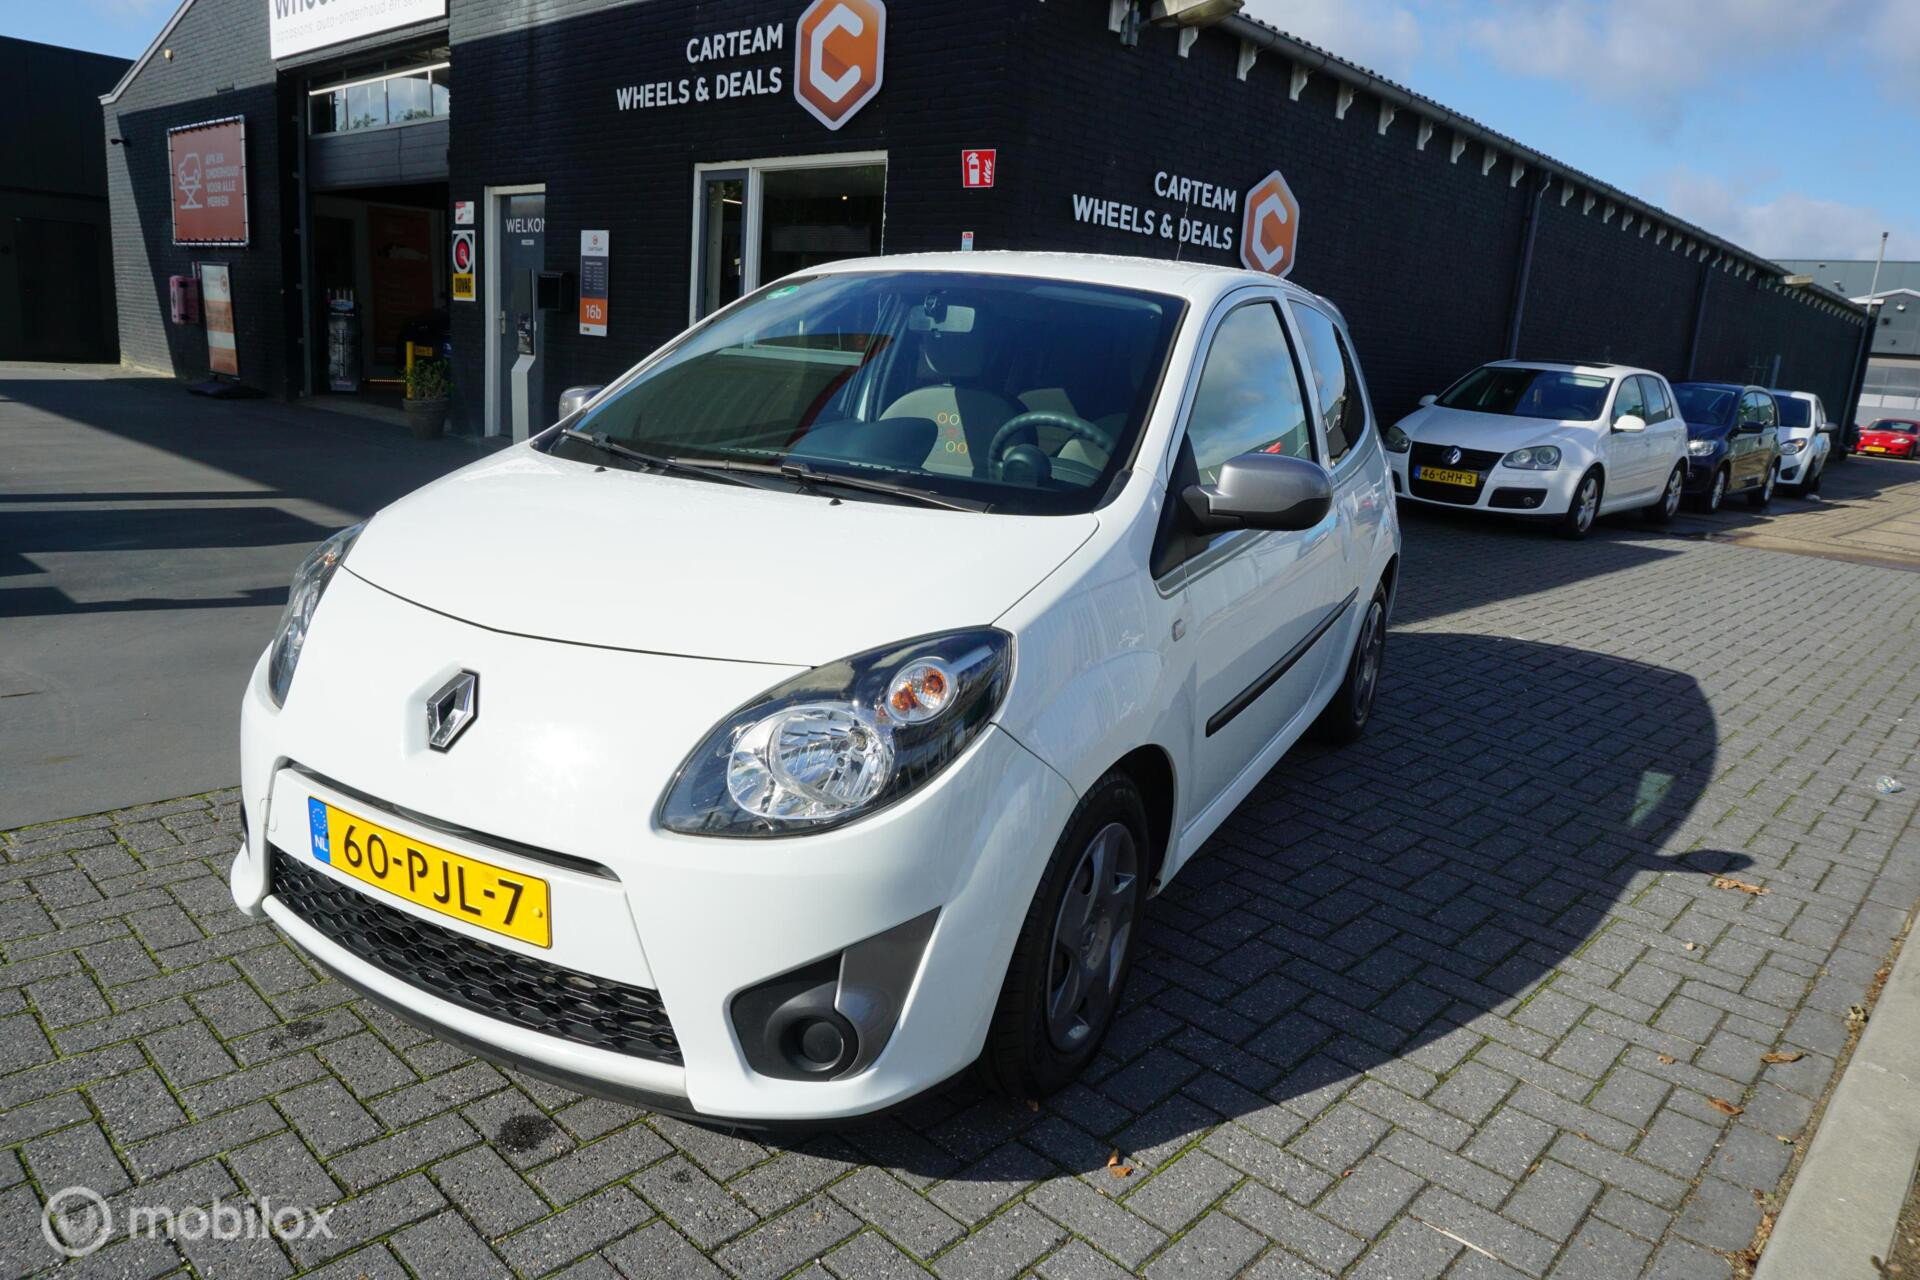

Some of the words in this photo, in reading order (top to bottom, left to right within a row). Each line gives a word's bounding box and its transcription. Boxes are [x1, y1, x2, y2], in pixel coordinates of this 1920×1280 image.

[686, 23, 783, 64] CARTEAM
[616, 78, 691, 111] WHEELS
[695, 77, 710, 102] &
[716, 67, 783, 100] DEALS
[1154, 171, 1238, 214] CARTEAM
[1072, 193, 1156, 236] WHEELS
[1159, 213, 1174, 240] &
[1178, 217, 1234, 250] DEALS
[585, 303, 602, 320] 16b
[1422, 468, 1474, 485] 46-GHH-3
[314, 834, 329, 852] NL
[344, 824, 524, 926] 60-PJL-7
